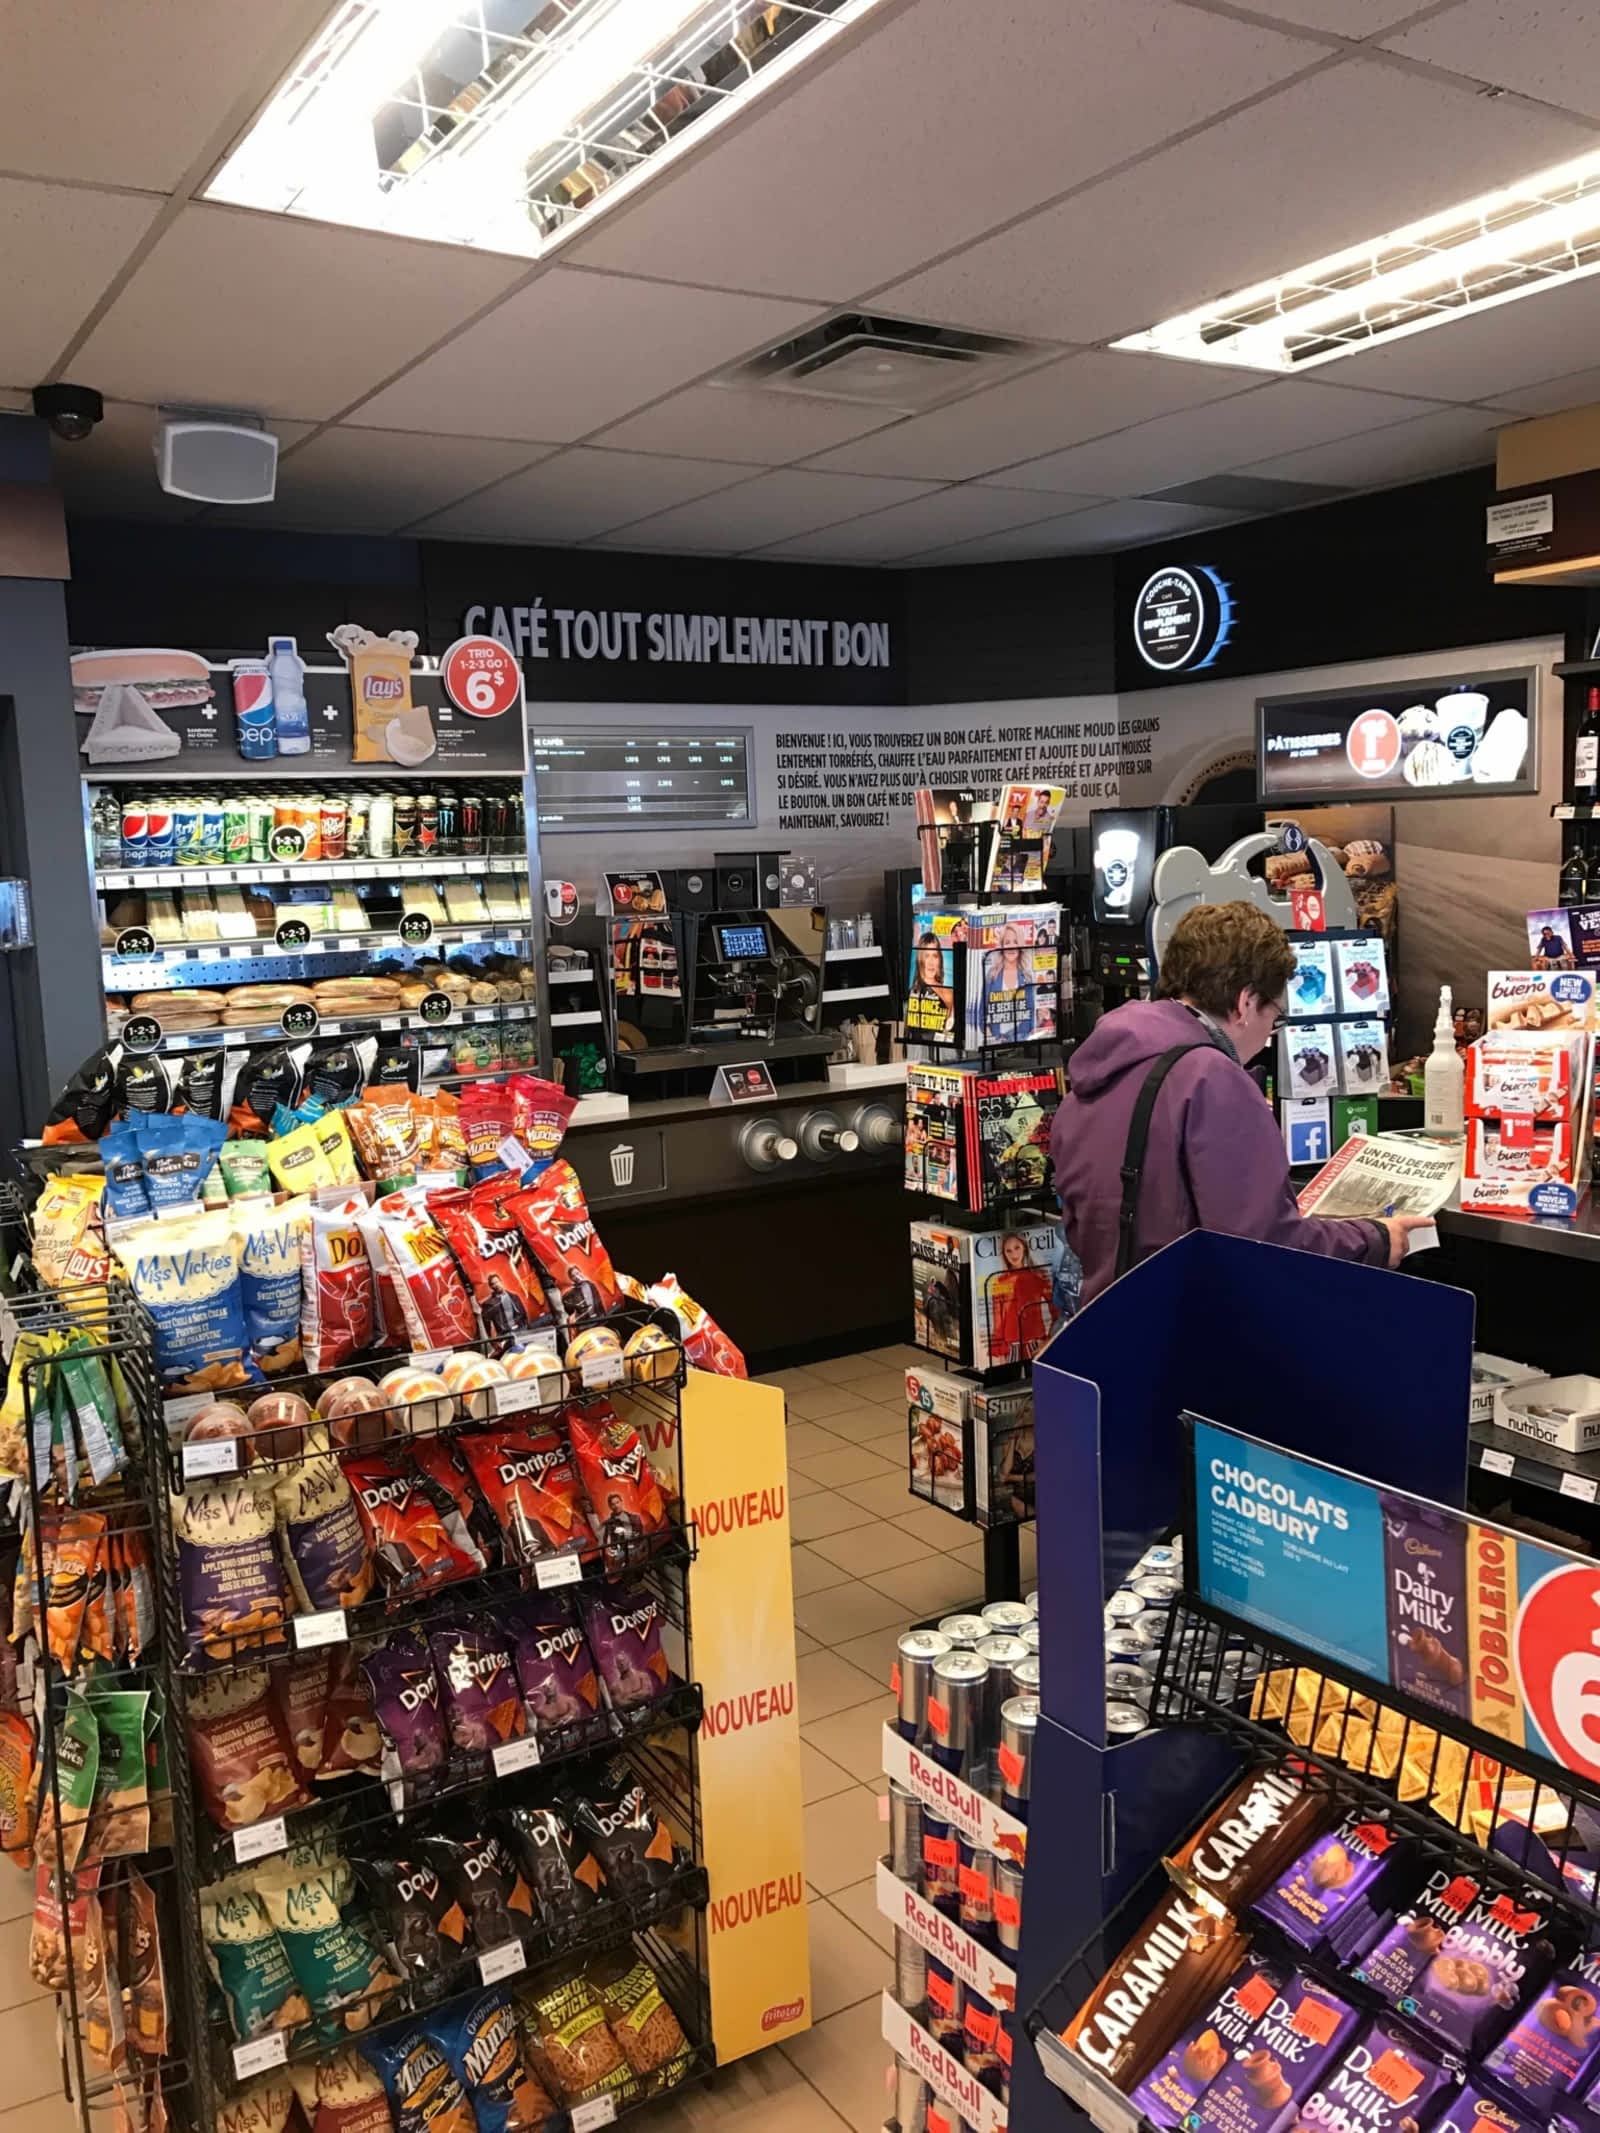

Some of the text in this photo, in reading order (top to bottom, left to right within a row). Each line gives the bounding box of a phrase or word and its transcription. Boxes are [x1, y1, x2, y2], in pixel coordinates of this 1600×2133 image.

[464, 598, 890, 668] CAFÉ TOUT SIMPLEMENT BON
[467, 649, 495, 659] TRIO
[776, 733, 826, 749] BIENVENUE
[833, 733, 848, 750] ICI,
[849, 733, 873, 748] VOUS
[873, 733, 924, 748] TROUVEREZ
[926, 731, 942, 746] UN
[943, 730, 966, 746] BON
[968, 725, 996, 745] CAFÉ.
[999, 726, 1032, 743] NOTRE
[1034, 724, 1077, 741] MACHINE
[1083, 722, 1116, 738] MOUD
[1117, 720, 1131, 736] LES
[1131, 717, 1161, 734] GRAINS
[1267, 732, 1342, 752] PÂTISSERIES
[776, 736, 1152, 770] LENTEMENT TORRÉFIÉS, CHAUFFE L'EAU PARFAITEMENT ET AJOUTE DU LAIT MOUSSÉ
[777, 759, 1153, 789] SI DÉSIRÉ. VOUS N'AVEZ PLUS QU'À CHOISIR VOTRE CAFÉ PRÉFÉRÉ ET APPUYER SUR
[778, 794, 788, 809] LE
[790, 793, 831, 809] BOUTON.
[832, 792, 845, 808] UN
[847, 792, 865, 808] BON
[866, 788, 887, 807] CAFÉ
[888, 792, 900, 807] NE
[1080, 783, 1103, 798] QUE
[1105, 782, 1120, 799] ÇA.
[1012, 793, 1026, 802] TV
[779, 814, 840, 831] MAINTENANT,
[840, 812, 884, 828] SAVOUREZ
[1491, 981, 1546, 1000] bueno
[1560, 977, 1583, 986] NEW
[1500, 1081, 1537, 1093] bueno
[1355, 1154, 1447, 1181] AVANT LA PLUIE
[1362, 1146, 1456, 1172] UN PEU DE RÉPIT
[1473, 1187, 1509, 1198] bueno
[242, 1229, 275, 1267] Miss
[132, 1248, 232, 1295] Miss Vickie's
[909, 1378, 919, 1398] 5
[1508, 1417, 1559, 1444] nutribar
[499, 1441, 573, 1485] Doritos
[183, 1492, 222, 1535] Miss
[691, 1485, 785, 1538] NOUVEAU
[1210, 1458, 1349, 1531] CHOCOLATS
[1211, 1485, 1319, 1545] CADBURY
[1394, 1568, 1455, 1616] Dairy
[1398, 1593, 1453, 1635] Milk
[701, 1681, 794, 1741] NOUVEAU
[909, 1750, 982, 1825] Red Bull
[710, 1871, 802, 1934] NOUVEAU
[904, 1890, 977, 1972] Red Bull
[1389, 1951, 1416, 1974] MILK
[1076, 1897, 1201, 2077] CARAMILK
[1253, 2017, 1306, 2064] Milk
[909, 2022, 981, 2113] Red Bull
[1207, 2088, 1259, 2130] CHOCOLATE
[1224, 2088, 1250, 2113] MILK
[1327, 2068, 1393, 2127] Milk
